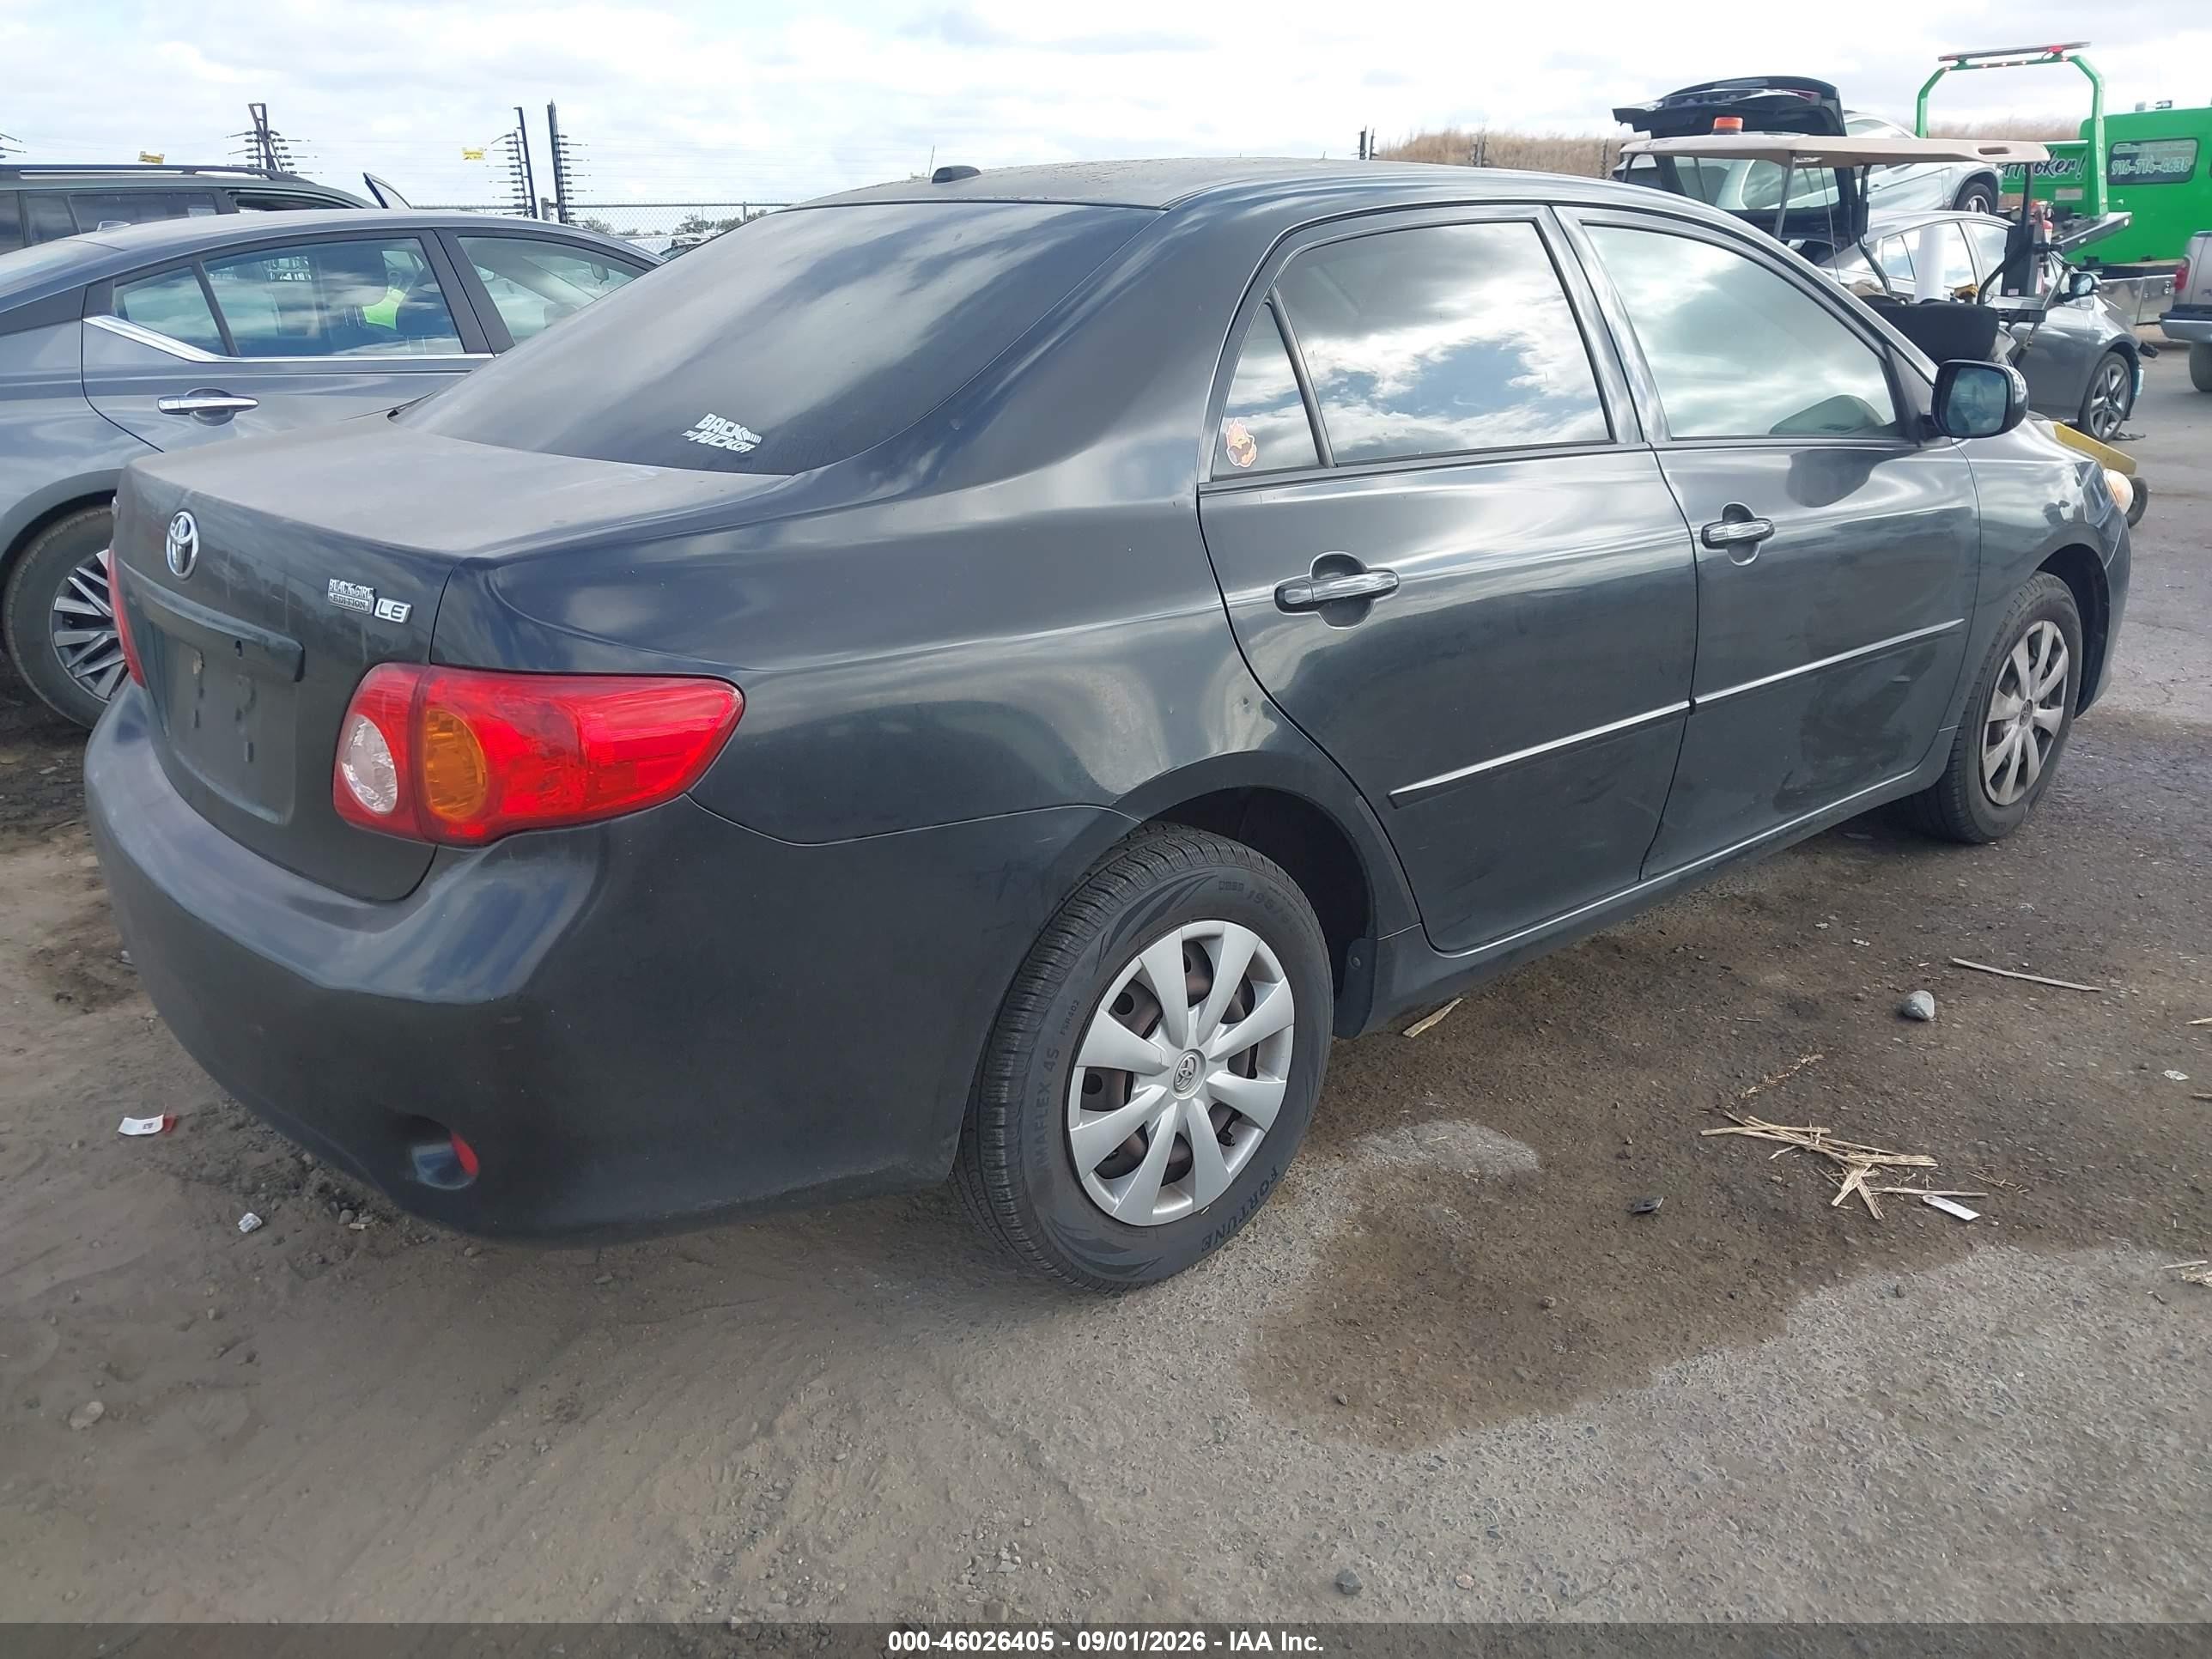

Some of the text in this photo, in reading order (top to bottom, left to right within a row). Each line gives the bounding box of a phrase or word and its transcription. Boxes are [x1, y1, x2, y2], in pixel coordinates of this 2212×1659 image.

[2000, 149, 2088, 179] Hoker!
[694, 413, 748, 441] BACK
[332, 594, 367, 611] EDITION
[378, 600, 405, 620] LE
[1200, 1164, 1279, 1253] FORTUNE
